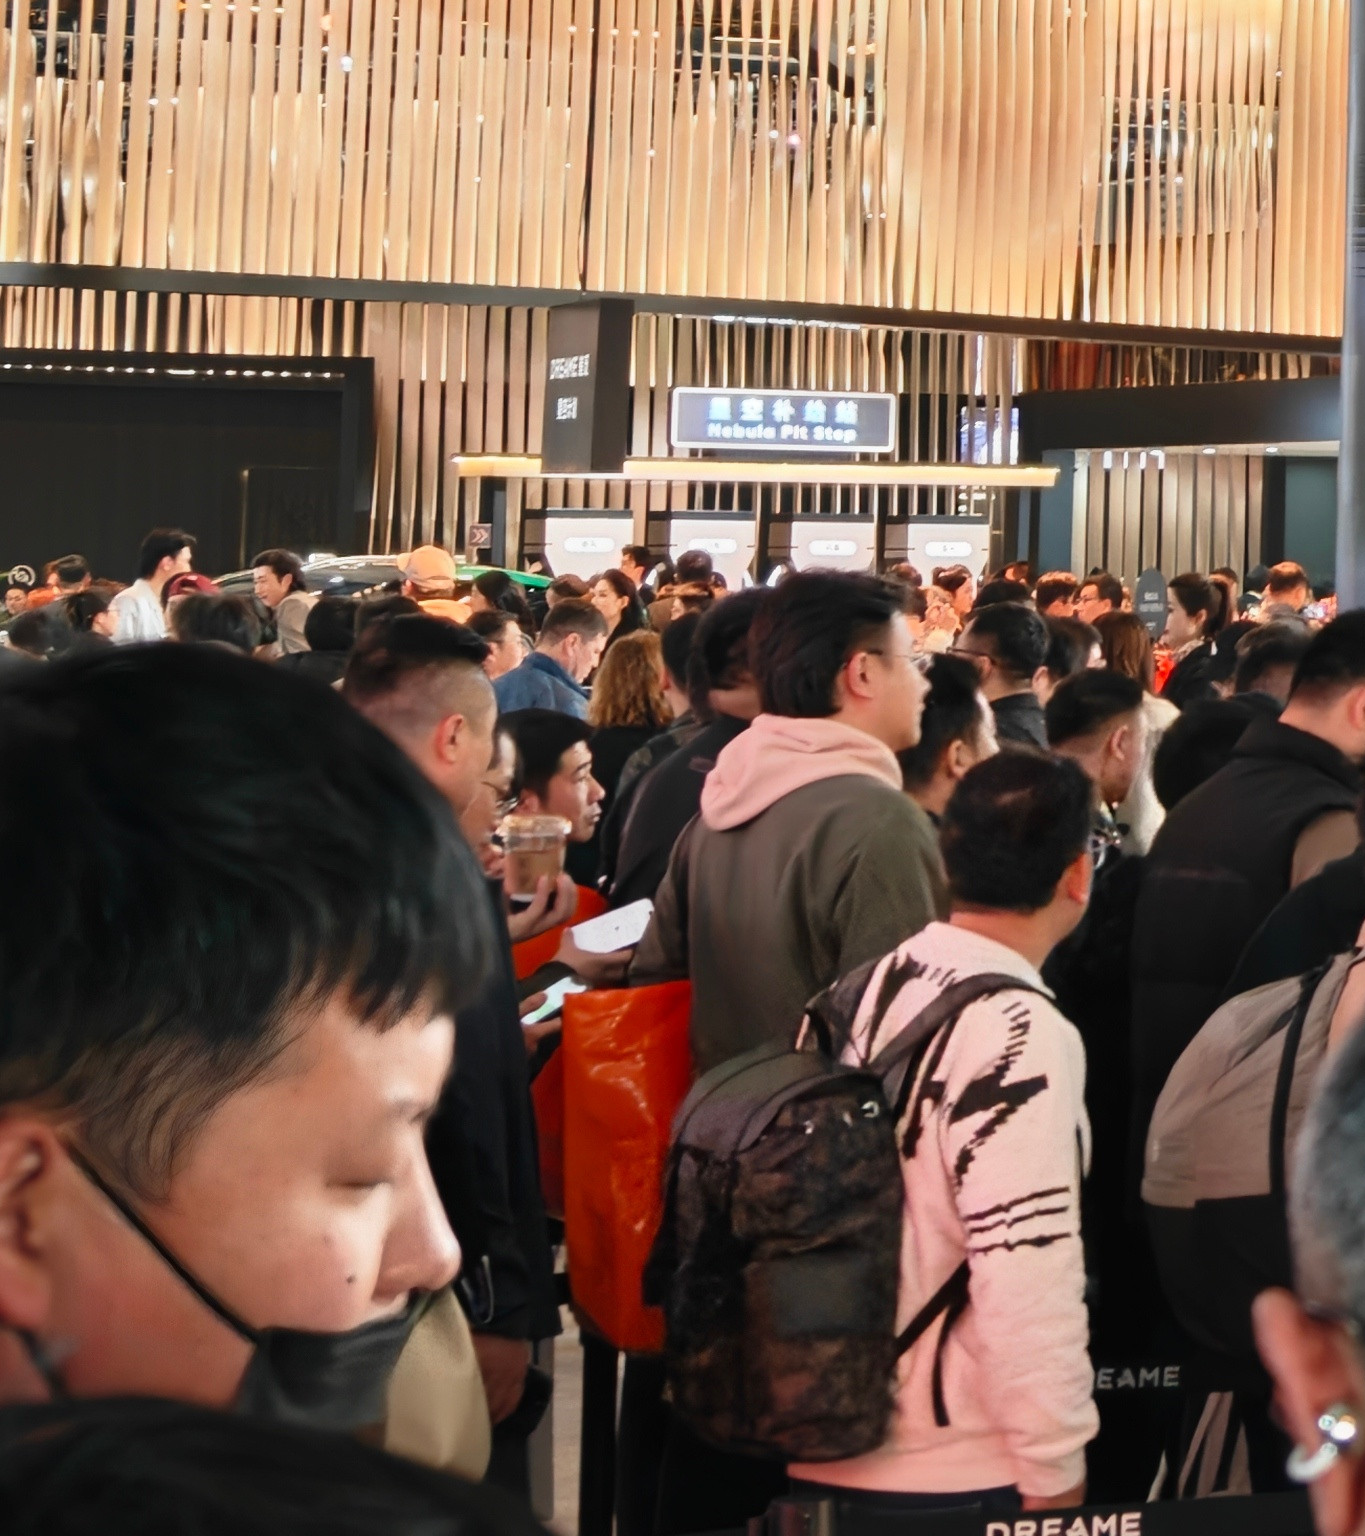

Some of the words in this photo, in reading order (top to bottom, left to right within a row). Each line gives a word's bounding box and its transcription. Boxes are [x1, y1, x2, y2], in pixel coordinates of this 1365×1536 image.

[707, 423, 776, 440] Nebula
[780, 424, 808, 441] Pit
[813, 425, 857, 444] Stop
[1096, 1366, 1181, 1390] EAME
